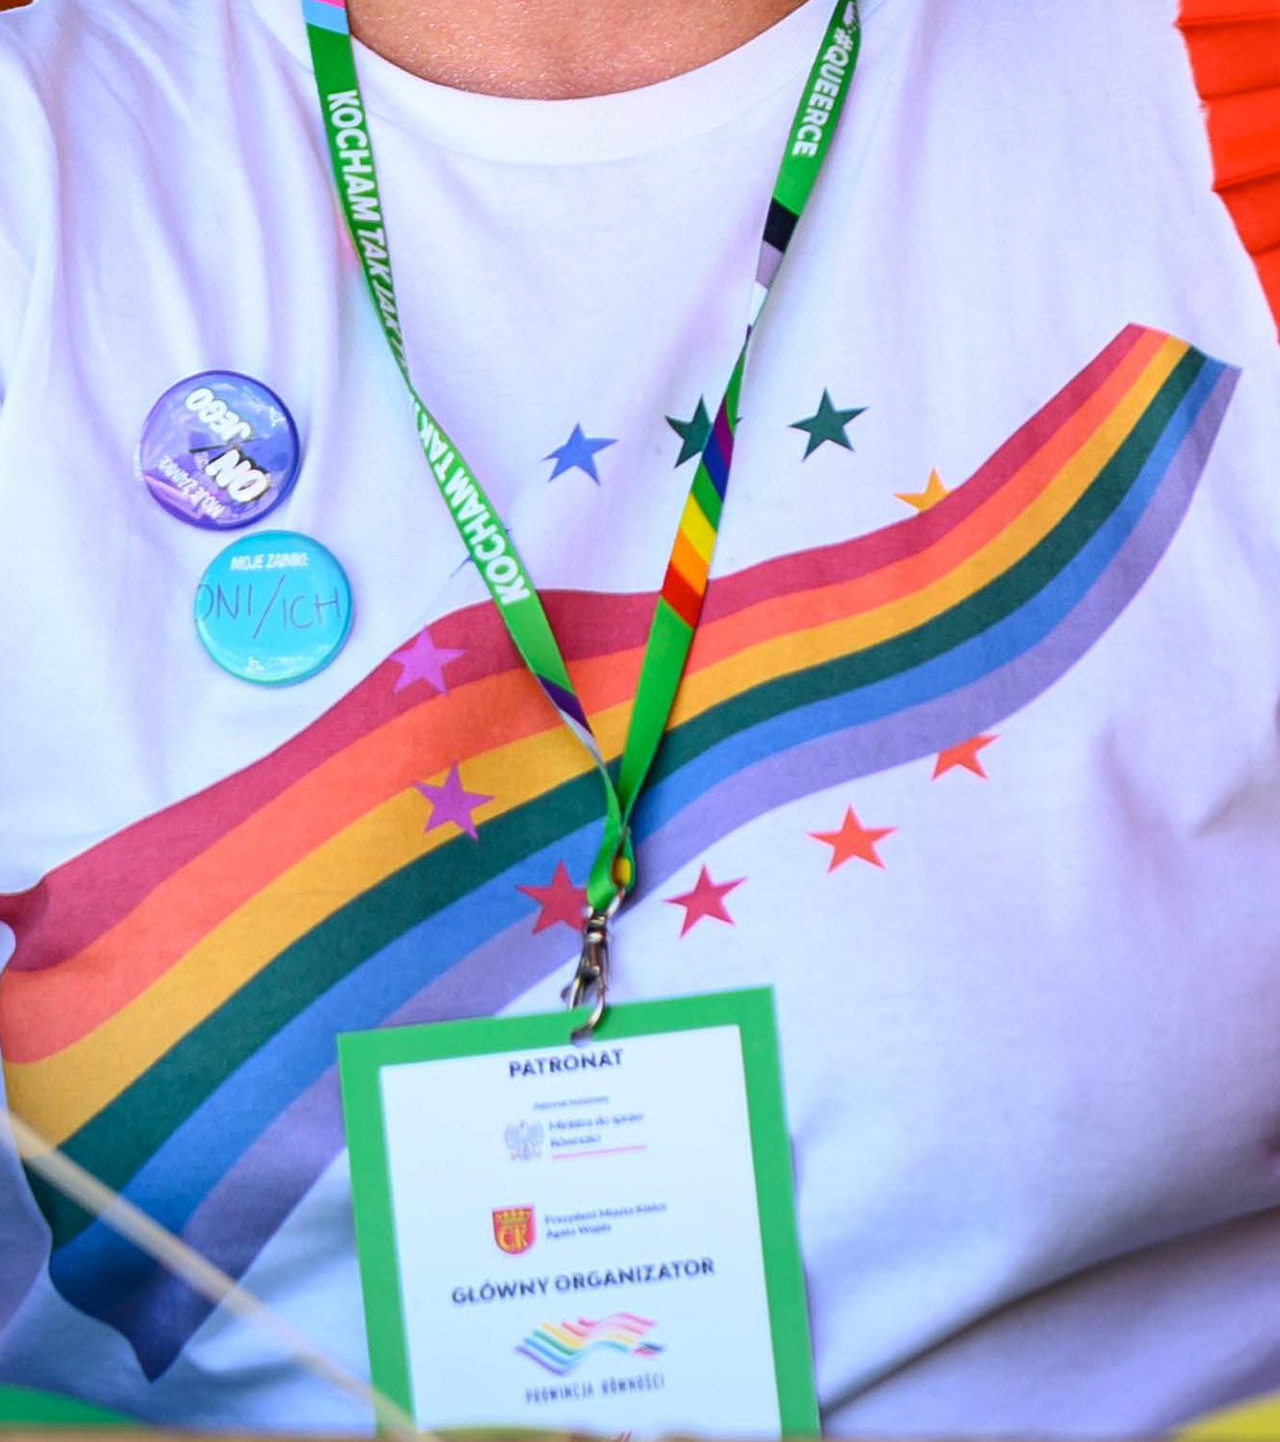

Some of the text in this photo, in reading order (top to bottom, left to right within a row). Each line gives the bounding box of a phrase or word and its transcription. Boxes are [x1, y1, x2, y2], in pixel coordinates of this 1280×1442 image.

[793, 27, 853, 158] #QUEERCE
[327, 89, 380, 221] KOCHAM
[357, 227, 392, 284] TAK
[420, 412, 531, 606] KOCHAM TAK
[509, 1049, 624, 1079] PATRONAT
[451, 1257, 716, 1306] GŁÓWNY ORGANIZATOR
[525, 1372, 666, 1405] PROWINCJA RÓWNOŚCI
